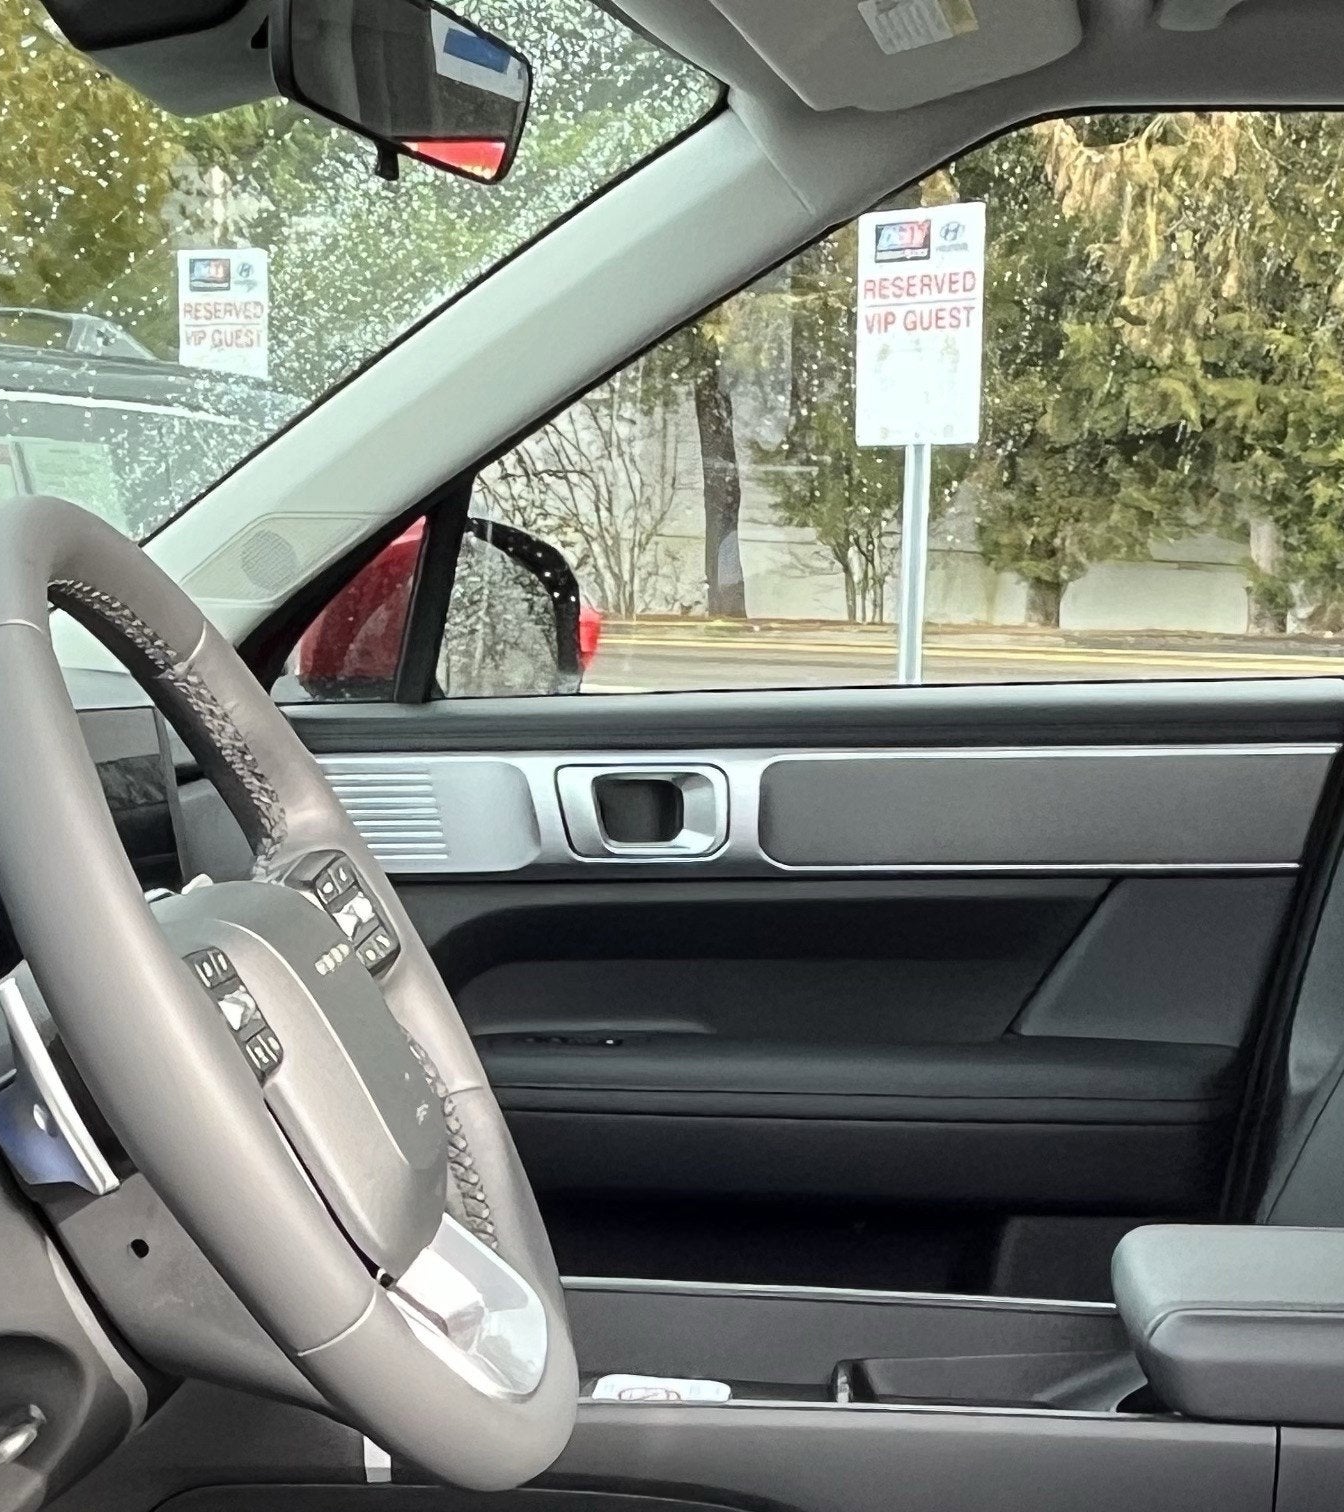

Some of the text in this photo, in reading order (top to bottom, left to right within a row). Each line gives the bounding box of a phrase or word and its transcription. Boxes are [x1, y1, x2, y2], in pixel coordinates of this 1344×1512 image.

[864, 271, 977, 300] RESERVED
[183, 301, 265, 321] RESERVED
[865, 306, 976, 335] VIP GUEST
[211, 328, 263, 349] GUEST
